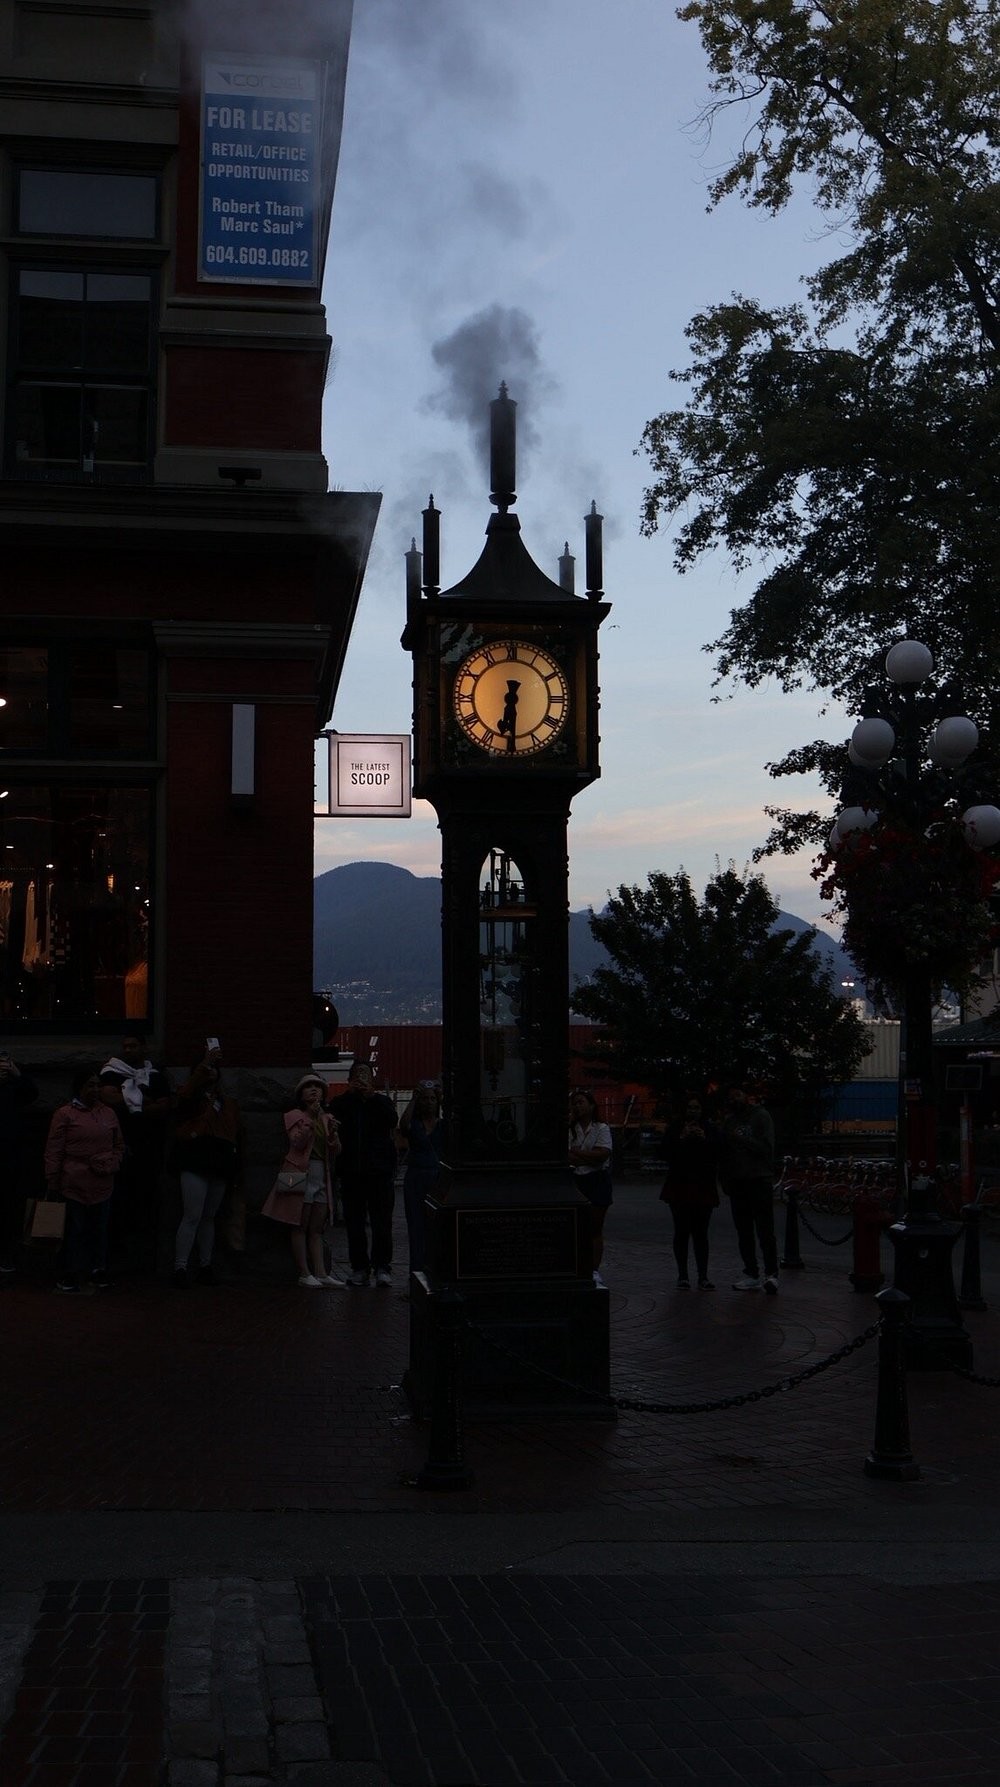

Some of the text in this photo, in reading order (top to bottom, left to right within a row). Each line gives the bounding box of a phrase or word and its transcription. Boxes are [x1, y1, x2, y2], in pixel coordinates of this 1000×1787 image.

[207, 106, 312, 134] FOR LEASE
[212, 142, 306, 161] RETAIL/OFFICE
[208, 163, 309, 183] OPPORTUNITIES
[213, 197, 304, 217] Robert Tham
[221, 216, 258, 233] Marc
[206, 245, 309, 268] 604.609.0882
[351, 763, 390, 771] THE LATEST
[351, 773, 390, 785] SCOOP
